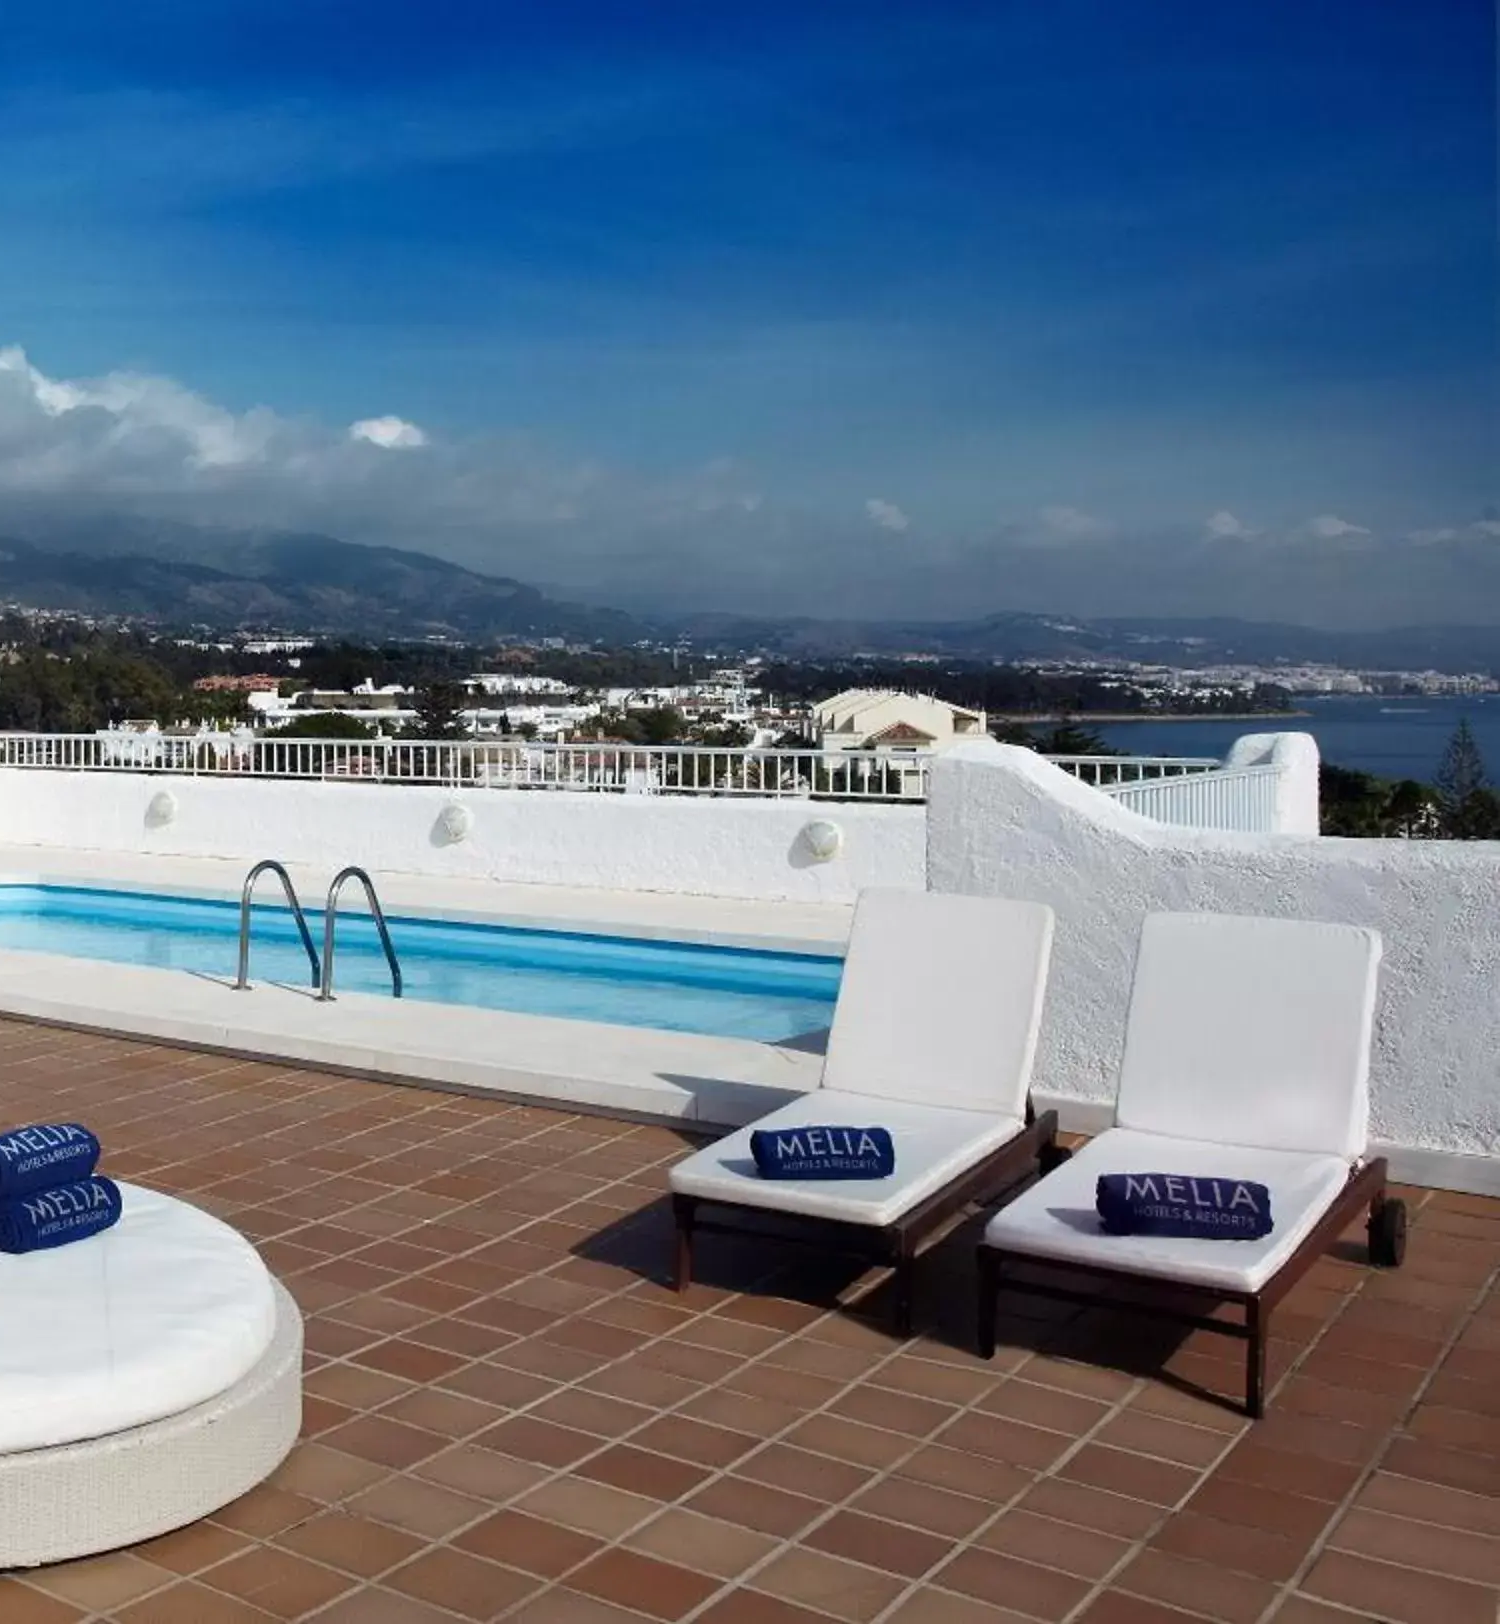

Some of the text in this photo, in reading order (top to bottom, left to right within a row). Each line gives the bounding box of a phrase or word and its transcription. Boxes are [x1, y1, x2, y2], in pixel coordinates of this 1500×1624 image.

[776, 1129, 881, 1159] MELIA
[22, 1183, 113, 1225] MELIA
[1125, 1175, 1260, 1213] MELIA
